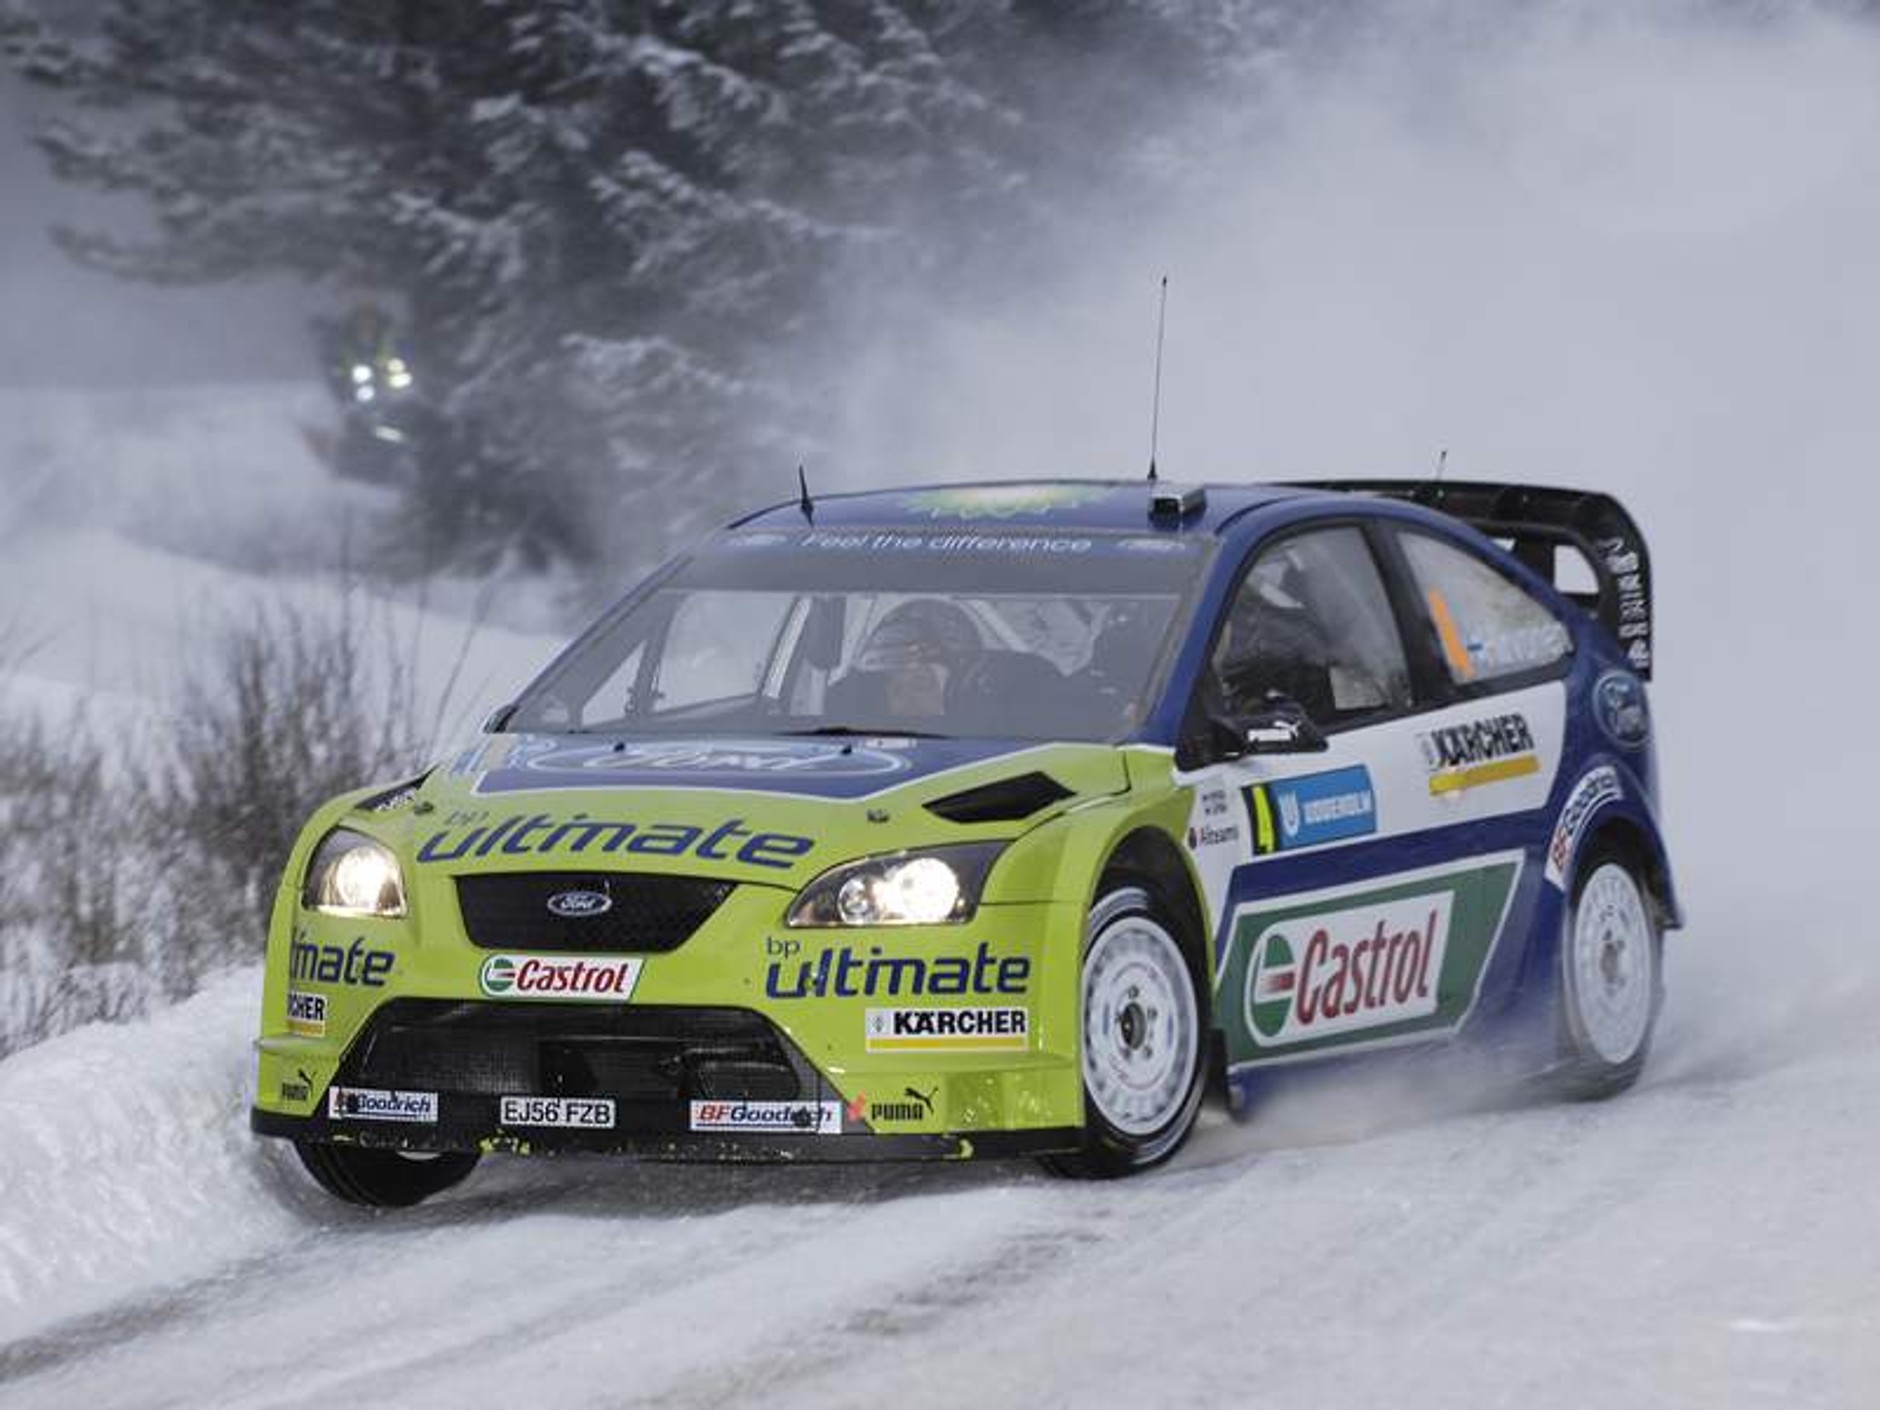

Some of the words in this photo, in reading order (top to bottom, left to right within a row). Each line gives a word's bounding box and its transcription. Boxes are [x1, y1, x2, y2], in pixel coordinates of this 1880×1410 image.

[801, 533, 868, 548] Feel
[872, 534, 922, 549] the
[929, 536, 1092, 551] difference
[415, 813, 815, 870] ultimate
[766, 936, 799, 961] bp
[517, 958, 629, 993] Castrol
[765, 941, 1030, 999] ultimate
[1296, 909, 1437, 1025] Castrol
[893, 1010, 1026, 1035] KÄRCHER
[504, 1100, 560, 1123] EJ56
[566, 1102, 610, 1125] FZB
